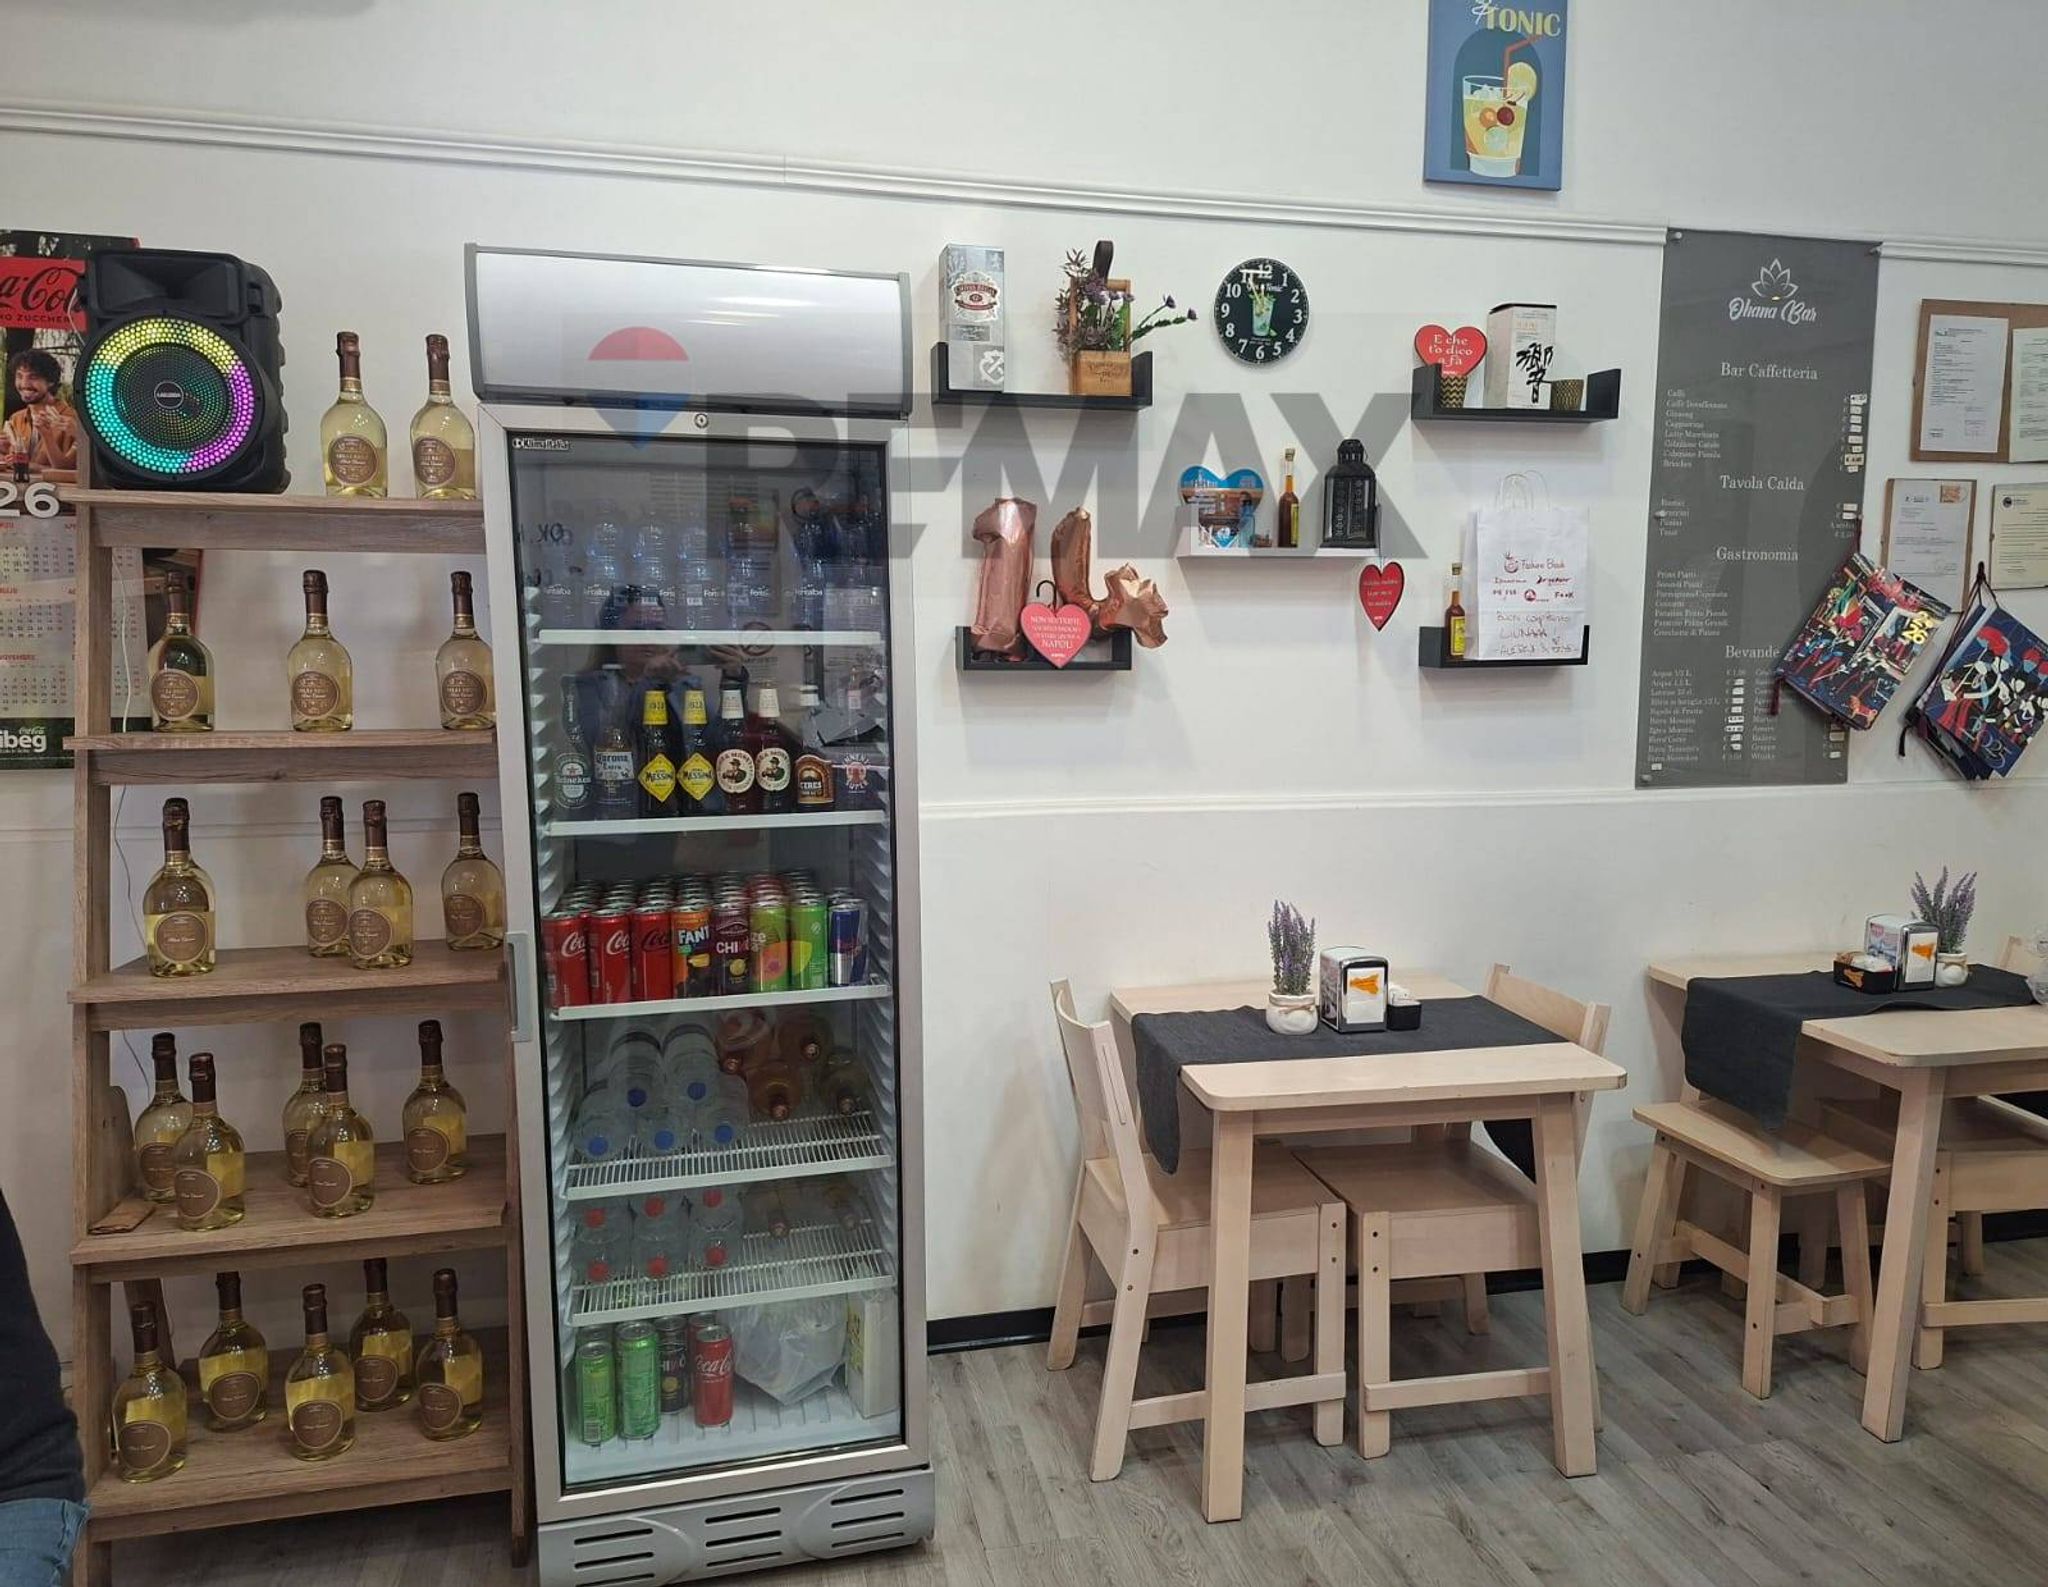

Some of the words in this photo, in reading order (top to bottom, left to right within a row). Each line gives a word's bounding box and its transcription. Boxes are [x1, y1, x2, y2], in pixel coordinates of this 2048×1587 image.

[1486, 6, 1561, 37] TONIC
[1226, 284, 1242, 298] 10
[1291, 289, 1300, 303] 2
[1221, 304, 1230, 318] 9
[1293, 310, 1302, 324] 3
[1728, 297, 1776, 321] Ohana
[1780, 300, 1817, 325] Bar
[1225, 323, 1235, 337] 8
[1286, 328, 1295, 342] 4
[1238, 339, 1248, 353] 7
[1446, 334, 1468, 346] che
[1255, 345, 1265, 359] 6
[1272, 342, 1282, 355] 5
[1721, 362, 1745, 377] Bar
[1749, 363, 1818, 380] Caffetteria
[1720, 475, 1763, 489] Tavola
[1767, 476, 1804, 490] Calda
[1725, 645, 1780, 659] Bevande
